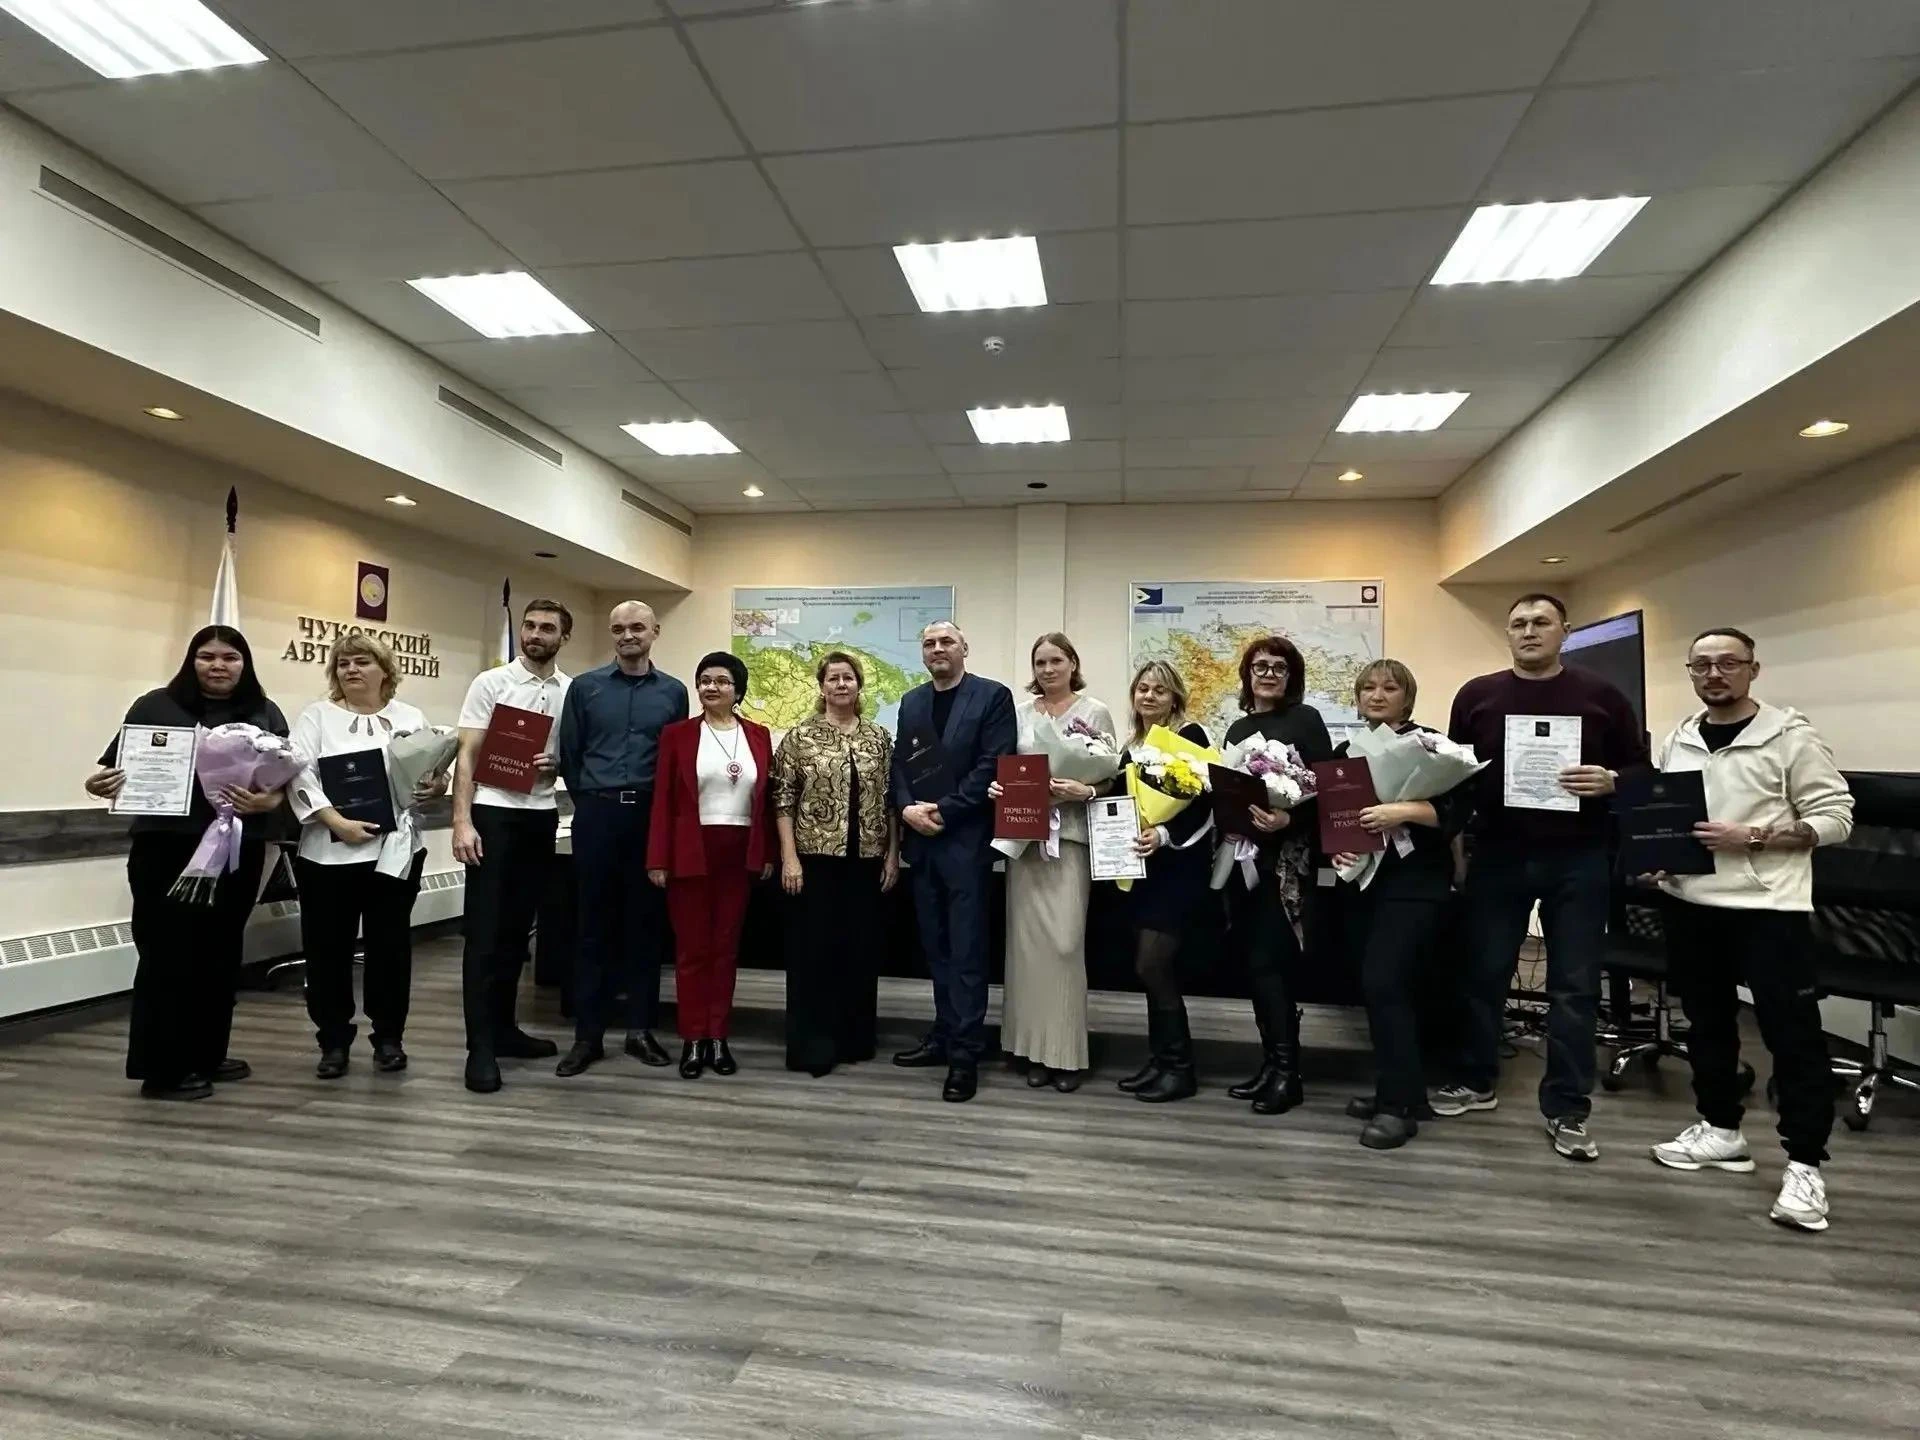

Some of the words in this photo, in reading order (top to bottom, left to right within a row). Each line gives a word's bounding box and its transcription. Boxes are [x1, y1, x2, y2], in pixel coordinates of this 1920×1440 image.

[281, 639, 440, 678] АВТНЫЙ
[489, 763, 524, 777] ГРАМОТА
[1334, 819, 1359, 828] ГРАМО
